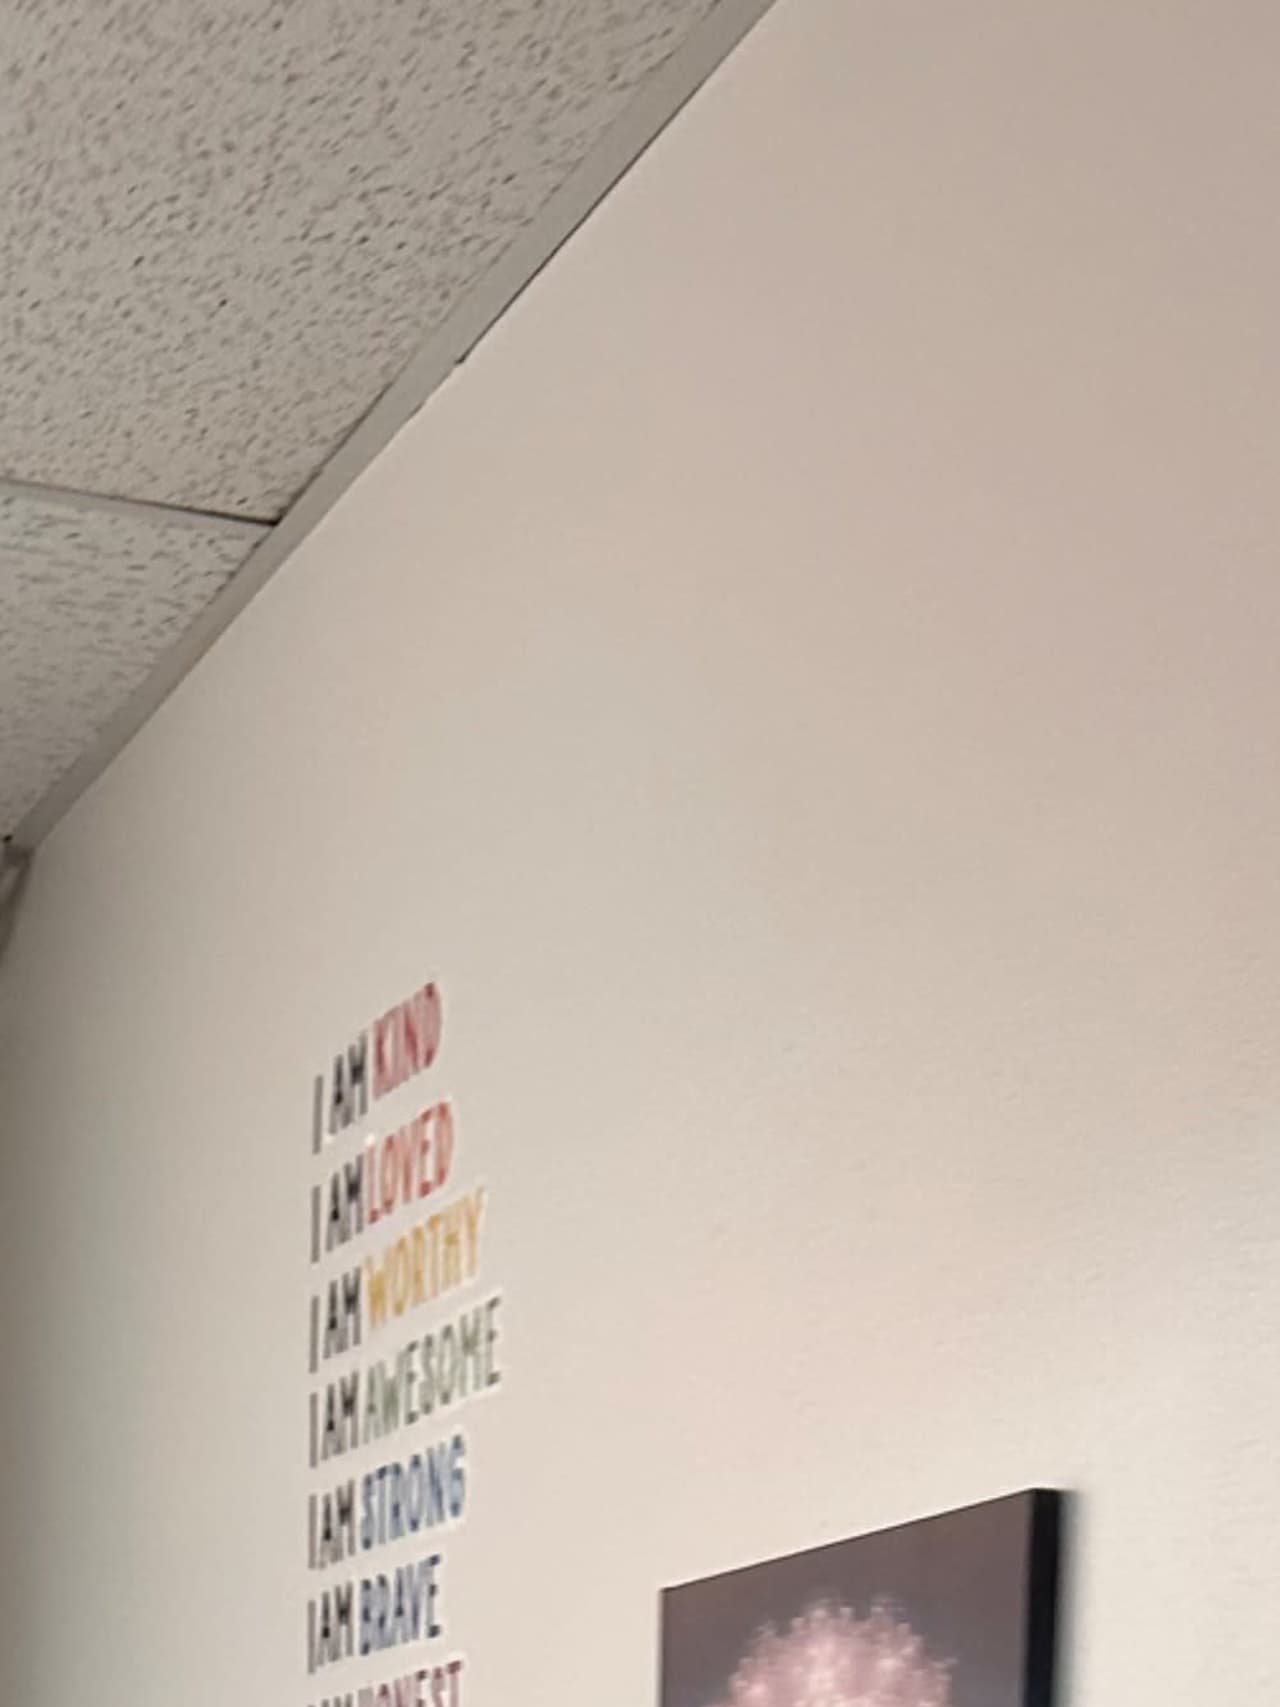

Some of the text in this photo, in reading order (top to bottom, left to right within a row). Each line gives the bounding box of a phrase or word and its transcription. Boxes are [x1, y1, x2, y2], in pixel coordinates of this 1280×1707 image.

[313, 980, 442, 1155] I AM KIND
[311, 1101, 454, 1264] I AM LOVED
[309, 1186, 486, 1374] I AM WORTHY
[309, 1296, 501, 1469] I AM AWESOME
[308, 1434, 466, 1570] I AM STRONG
[308, 1554, 441, 1675] I AM BRAVE
